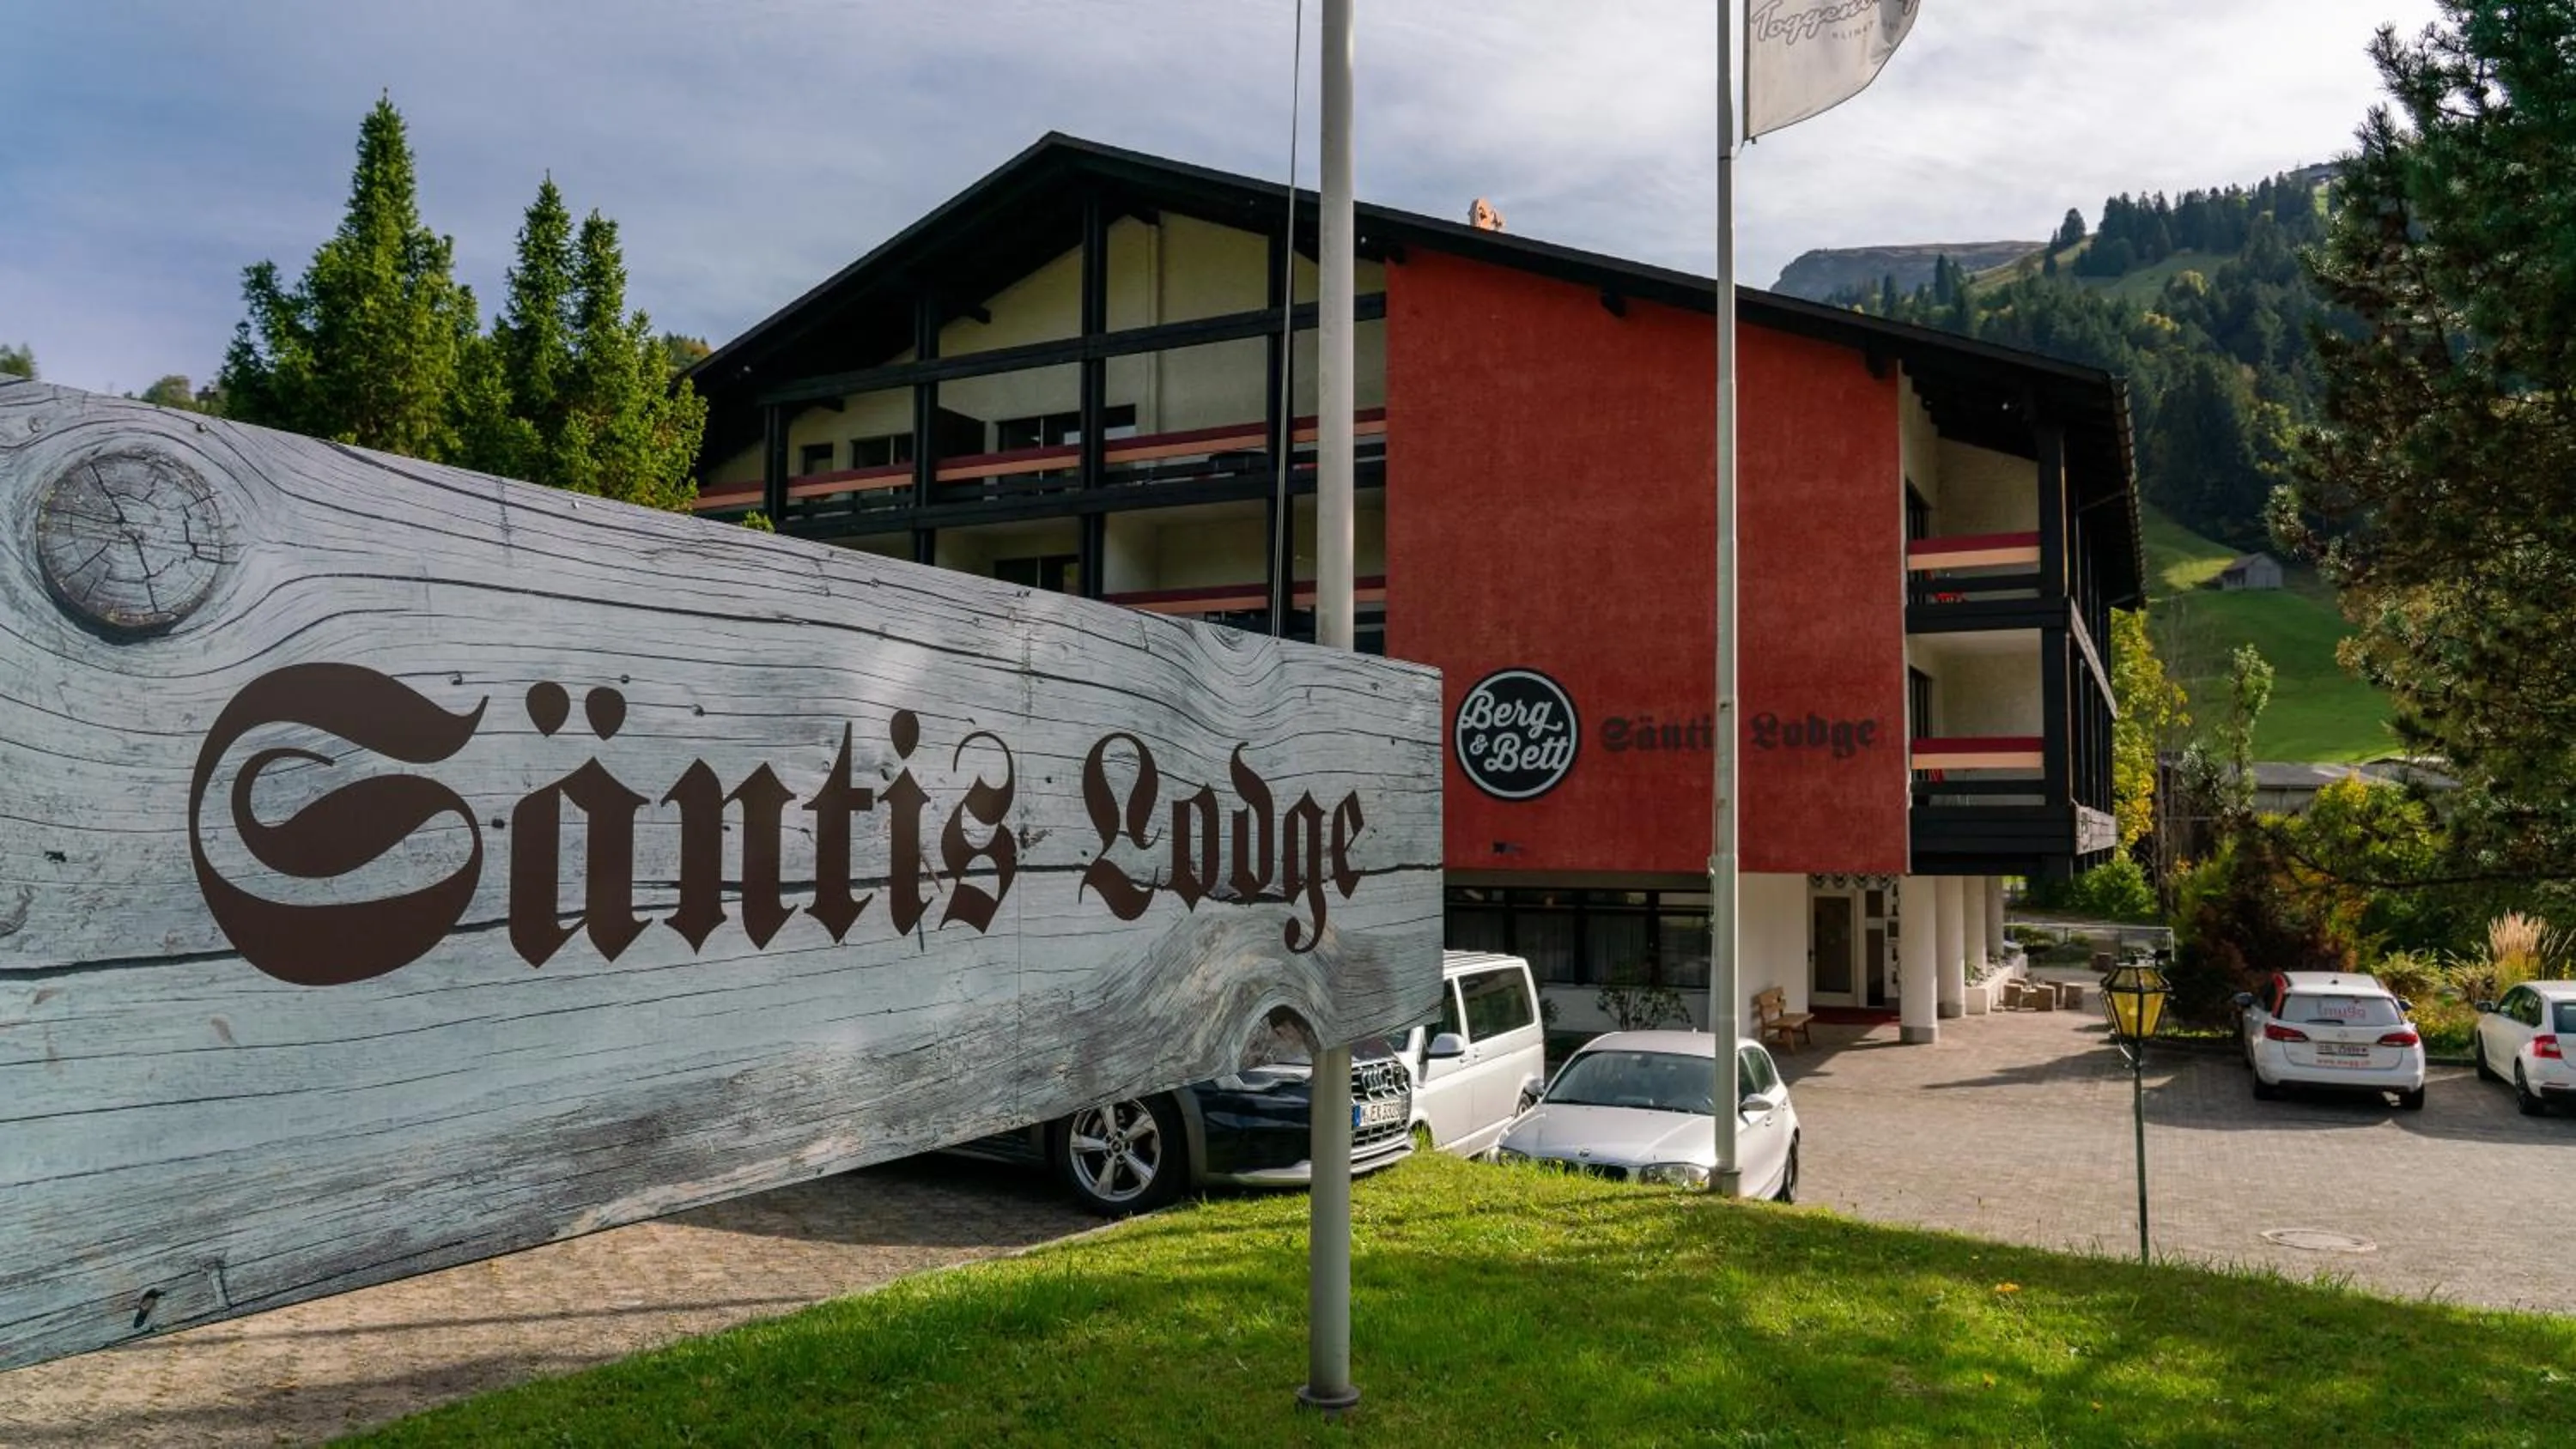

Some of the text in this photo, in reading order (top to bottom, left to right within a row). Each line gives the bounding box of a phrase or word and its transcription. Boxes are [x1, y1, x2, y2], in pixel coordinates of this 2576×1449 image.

[1460, 689, 1564, 739] Berg
[1599, 712, 1876, 759] Sänti Lodge
[1469, 732, 1569, 772] & Bett
[188, 662, 1366, 986] Säntis Lodge
